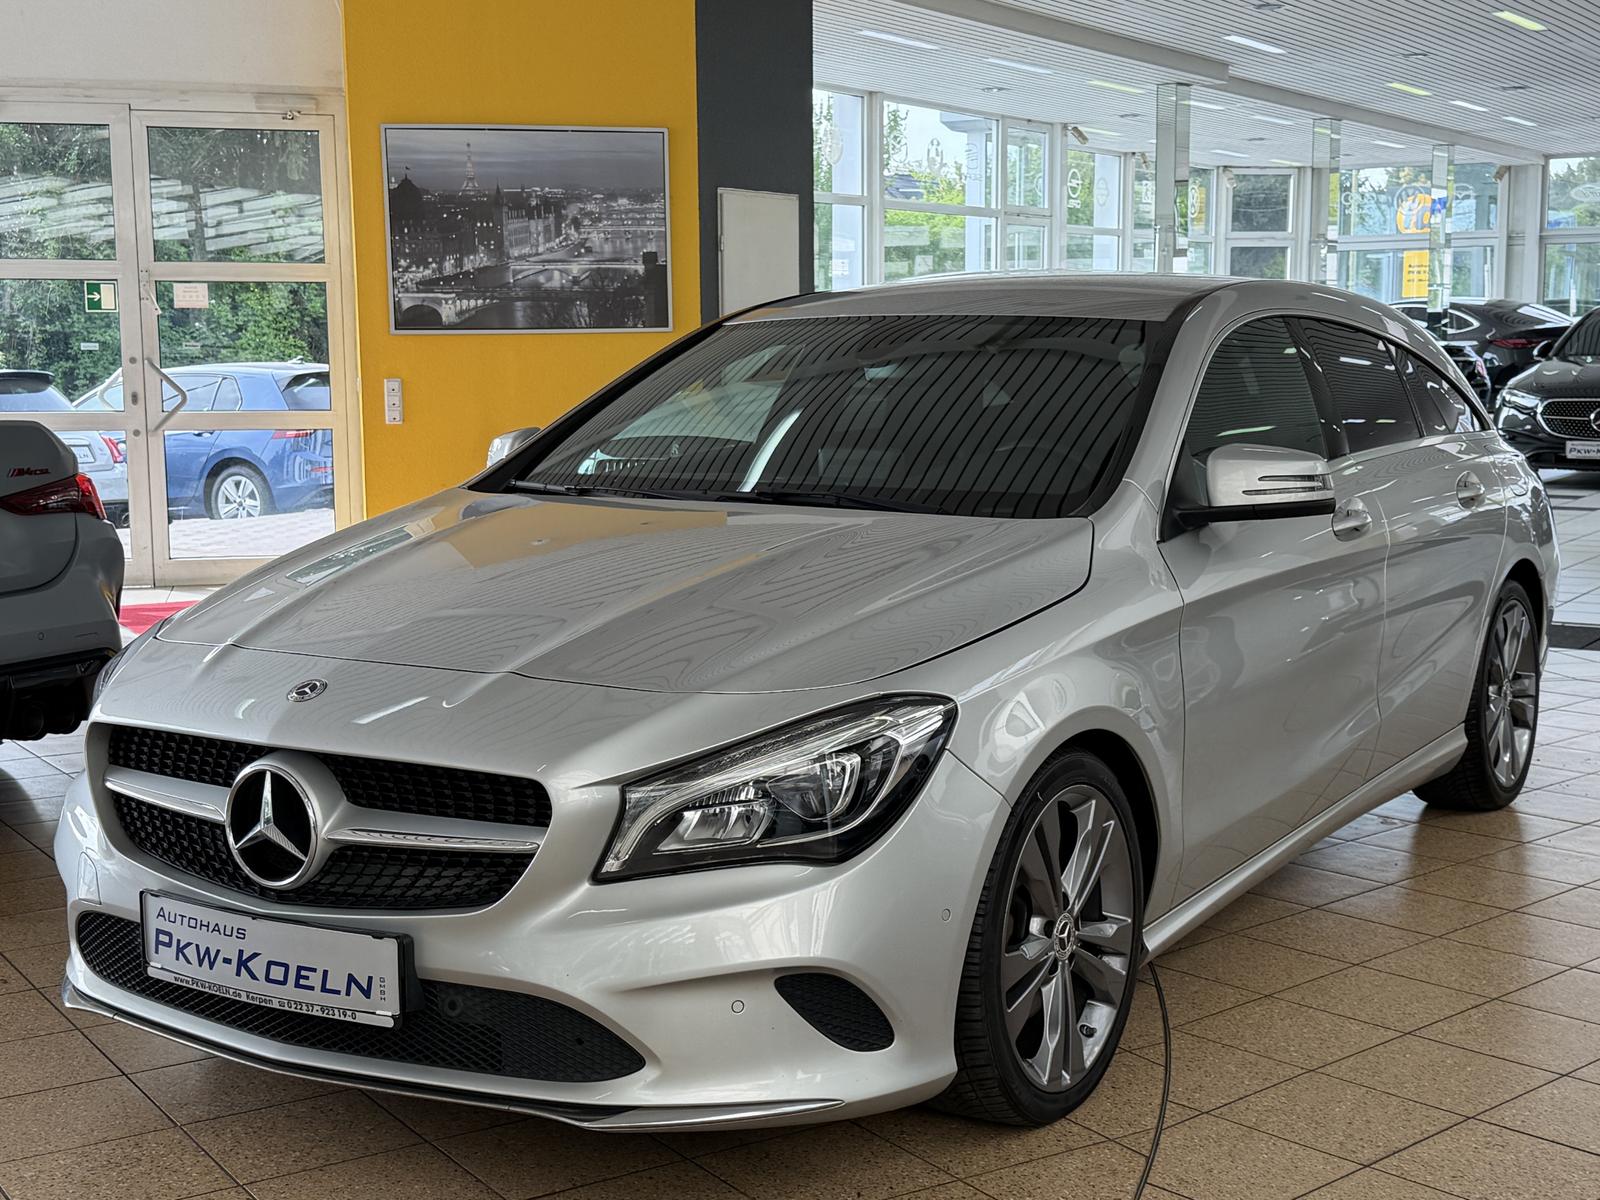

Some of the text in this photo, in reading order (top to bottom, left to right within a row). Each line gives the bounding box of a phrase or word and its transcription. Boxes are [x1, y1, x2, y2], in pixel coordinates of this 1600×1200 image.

[156, 907, 247, 940] AUTOHAUS
[154, 928, 374, 1000] PKW-KOELN
[245, 991, 274, 1006] Kerpen
